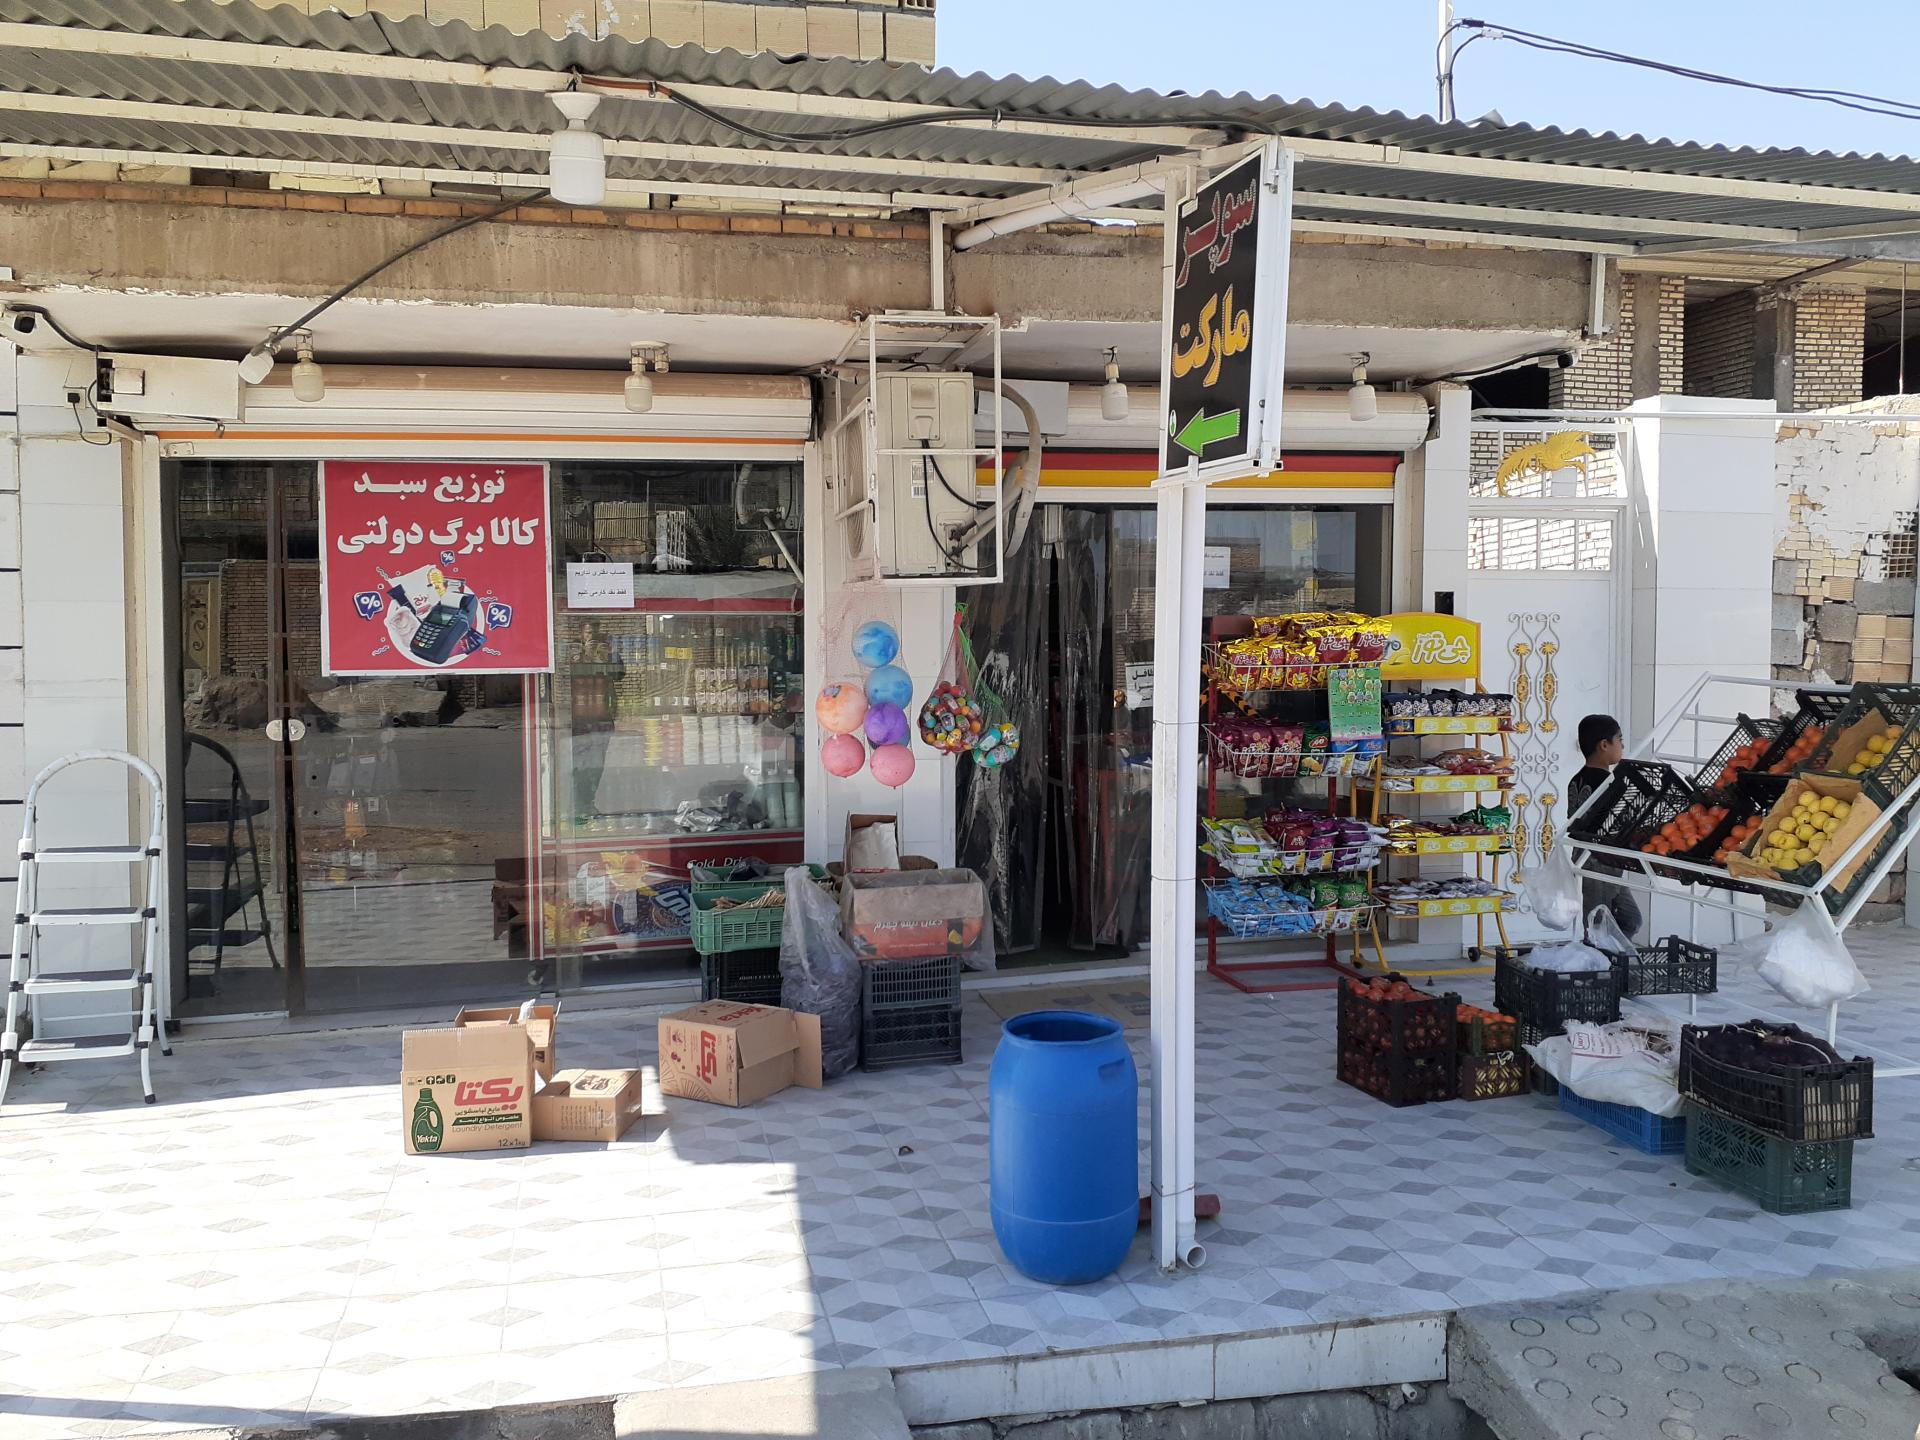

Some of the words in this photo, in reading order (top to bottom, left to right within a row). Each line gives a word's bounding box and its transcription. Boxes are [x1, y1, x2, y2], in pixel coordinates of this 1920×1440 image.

[1176, 178, 1257, 289] سوپر
[1171, 283, 1251, 388] مارکت
[353, 471, 428, 501] سبد
[433, 469, 505, 503] توزیع
[336, 514, 424, 555] دولتی
[695, 1029, 718, 1085] یکتا
[454, 1077, 524, 1111] یکتا
[416, 1134, 438, 1144] Yekta
[452, 1124, 482, 1134] Laundry
[484, 1122, 523, 1131] Detergent
